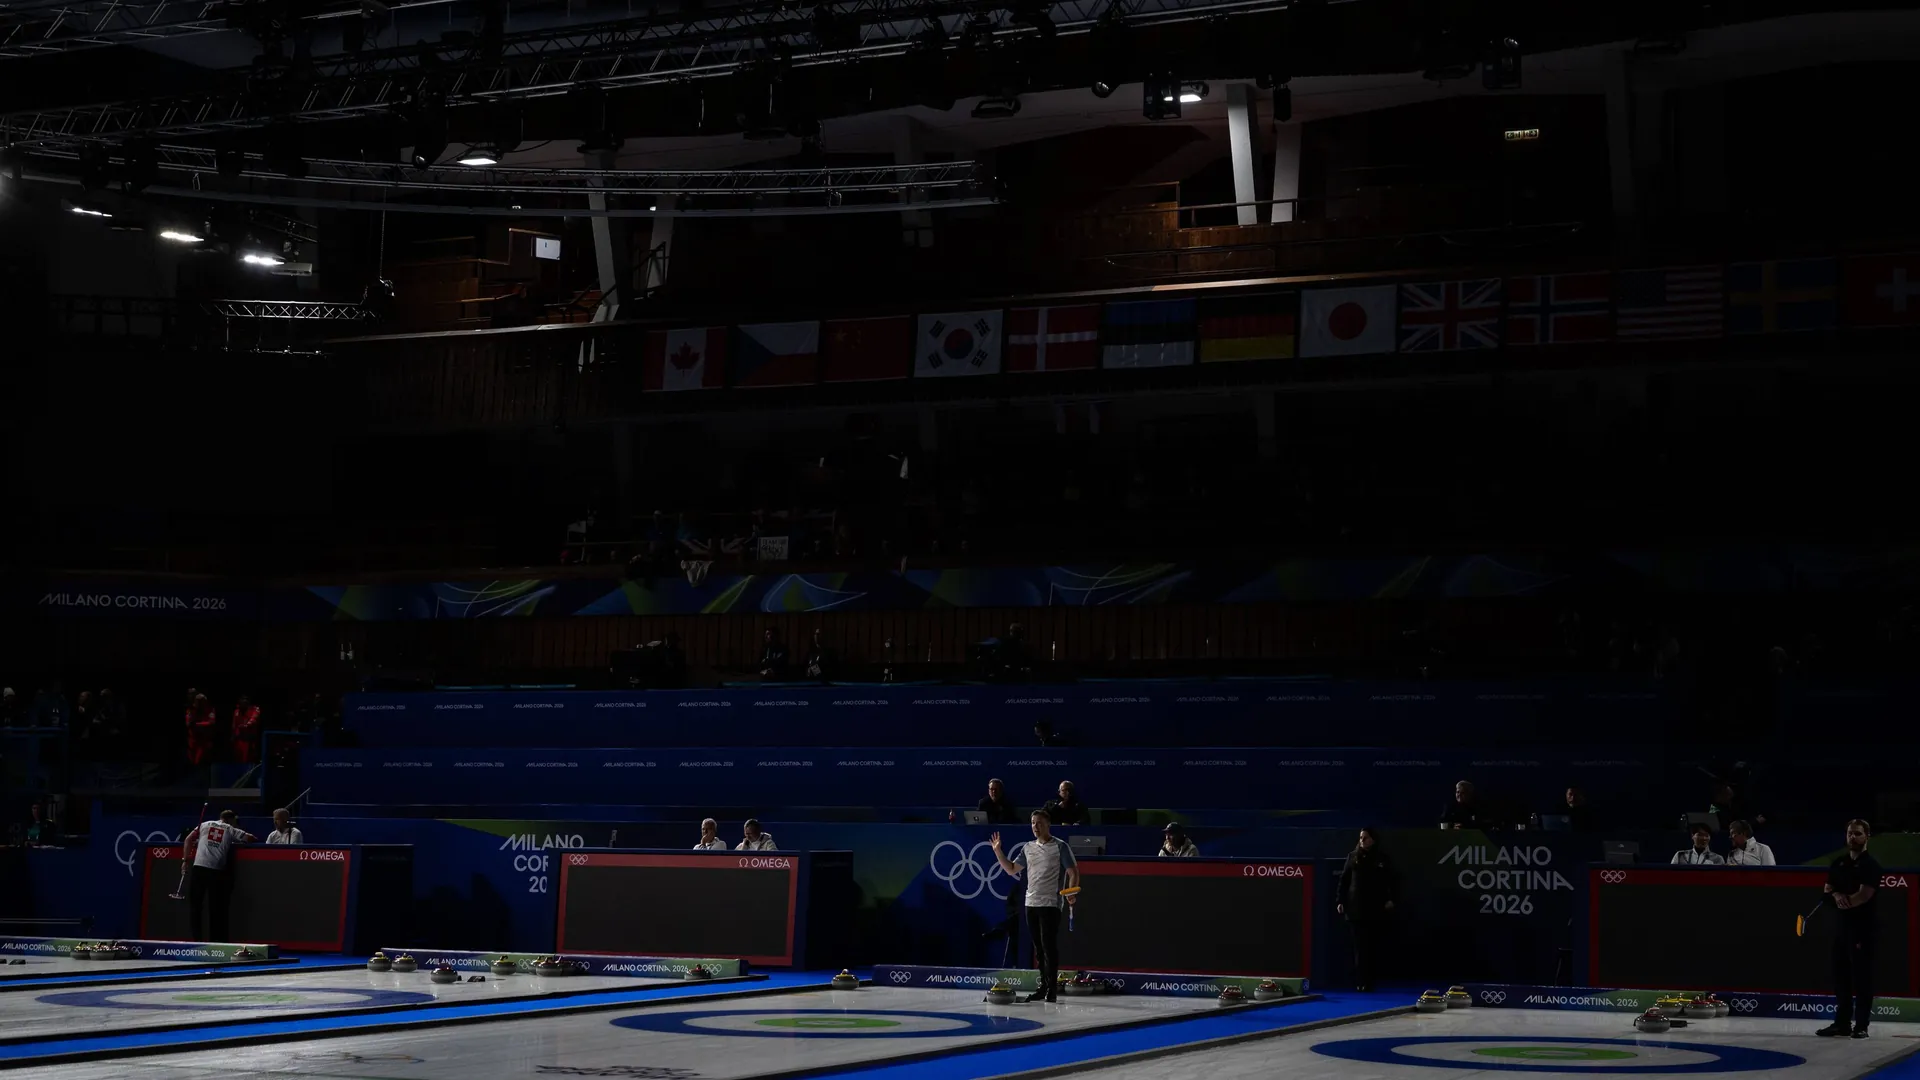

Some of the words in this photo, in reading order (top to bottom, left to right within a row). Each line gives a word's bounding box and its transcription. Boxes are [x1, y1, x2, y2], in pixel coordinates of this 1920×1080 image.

[38, 593, 111, 607] MILANO
[115, 595, 188, 609] CORTINA
[192, 597, 226, 610] 2026
[1088, 696, 1113, 704] MILANO
[1114, 696, 1138, 704] CORTINA
[1138, 696, 1151, 704] 2026
[1176, 695, 1201, 703] MILANO
[1202, 695, 1226, 703] CORTINA
[1227, 695, 1240, 703] 2026
[922, 759, 945, 767] MILANO
[946, 759, 969, 767] CORTINA
[970, 759, 983, 767] 2026
[1277, 759, 1304, 767] MILANO
[1305, 759, 1330, 767] CORTINA
[1332, 759, 1347, 767] 2026
[498, 833, 584, 851] MILANO
[310, 851, 345, 861] OMEGA
[1437, 845, 1552, 866] MILANO
[751, 858, 790, 868] OMEGA
[1257, 865, 1303, 877] OMEGA
[529, 875, 548, 893] 20
[1457, 869, 1575, 891] CORTINA
[1879, 875, 1908, 888] EGA
[1480, 894, 1534, 915] 2026
[1, 942, 29, 951] MILANO
[29, 943, 56, 952] CORTINA
[57, 944, 71, 952] 2026
[152, 948, 180, 957] MILANO
[180, 949, 209, 957] CORTINA
[211, 949, 225, 958] 2026
[425, 958, 456, 966] MILANO
[457, 958, 489, 967] CORTINA
[602, 963, 636, 972] MILANO
[636, 964, 671, 973] CORTINA
[672, 965, 688, 973] 2026
[926, 974, 962, 983] MILANO
[963, 975, 1000, 984] CORTINA
[1003, 977, 1022, 985] 2026
[1140, 981, 1179, 991] MILANO
[1180, 983, 1221, 992] CORTINA
[1524, 994, 1568, 1005] MILANO
[1569, 996, 1615, 1007] CORTINA
[1616, 998, 1639, 1007] 2026
[1777, 1002, 1824, 1013] MILANO
[1877, 1006, 1901, 1015] 2026
